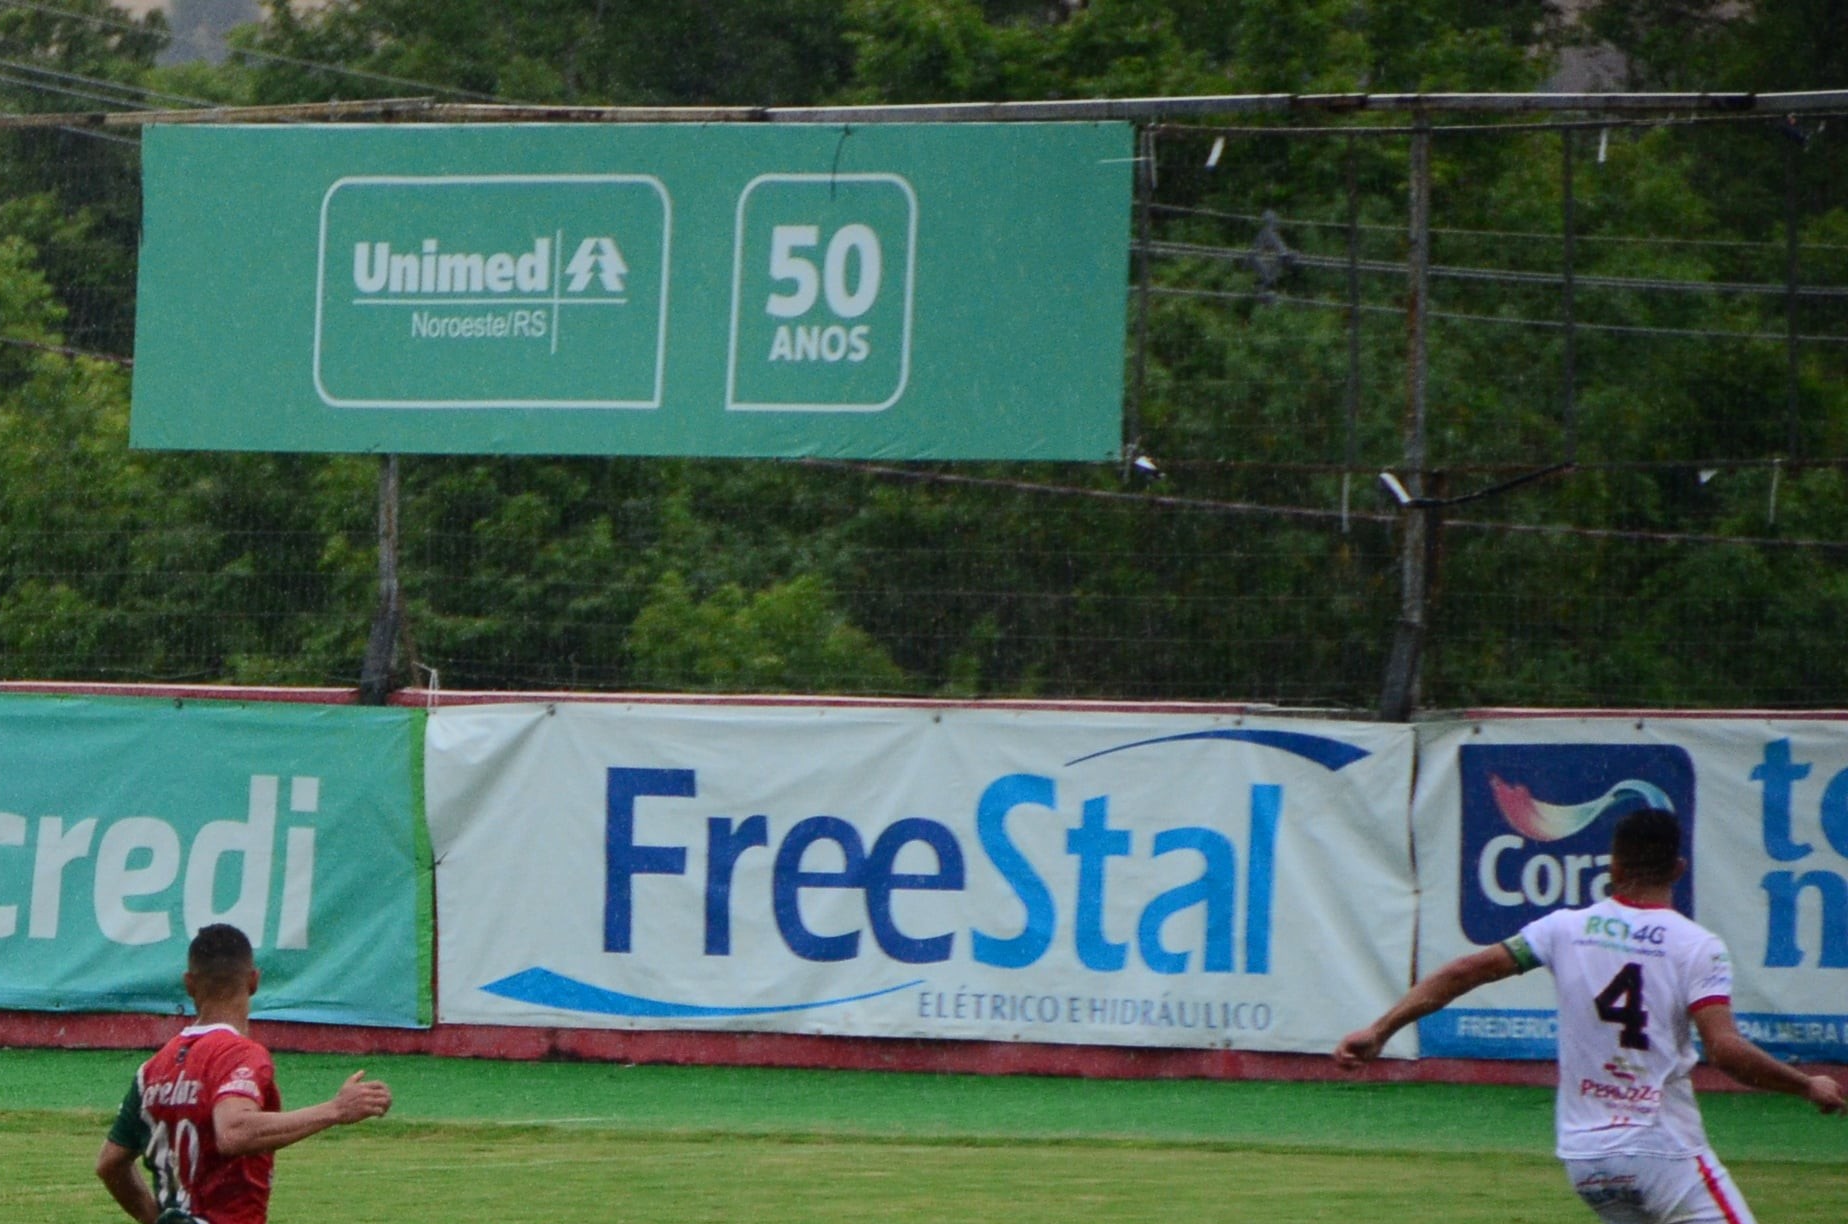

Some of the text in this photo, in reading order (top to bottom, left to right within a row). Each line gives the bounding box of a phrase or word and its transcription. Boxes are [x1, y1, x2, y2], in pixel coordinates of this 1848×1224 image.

[353, 236, 551, 293] Unimed
[765, 223, 883, 318] 50
[410, 309, 547, 339] Noroeste/RS
[767, 325, 870, 363] ANOS
[602, 766, 1283, 976] FreeStal
[1632, 924, 1666, 945] 4G
[918, 984, 1272, 1031] ELÉTRICO E HIDRÁULICO
[1594, 962, 1651, 1050] 4
